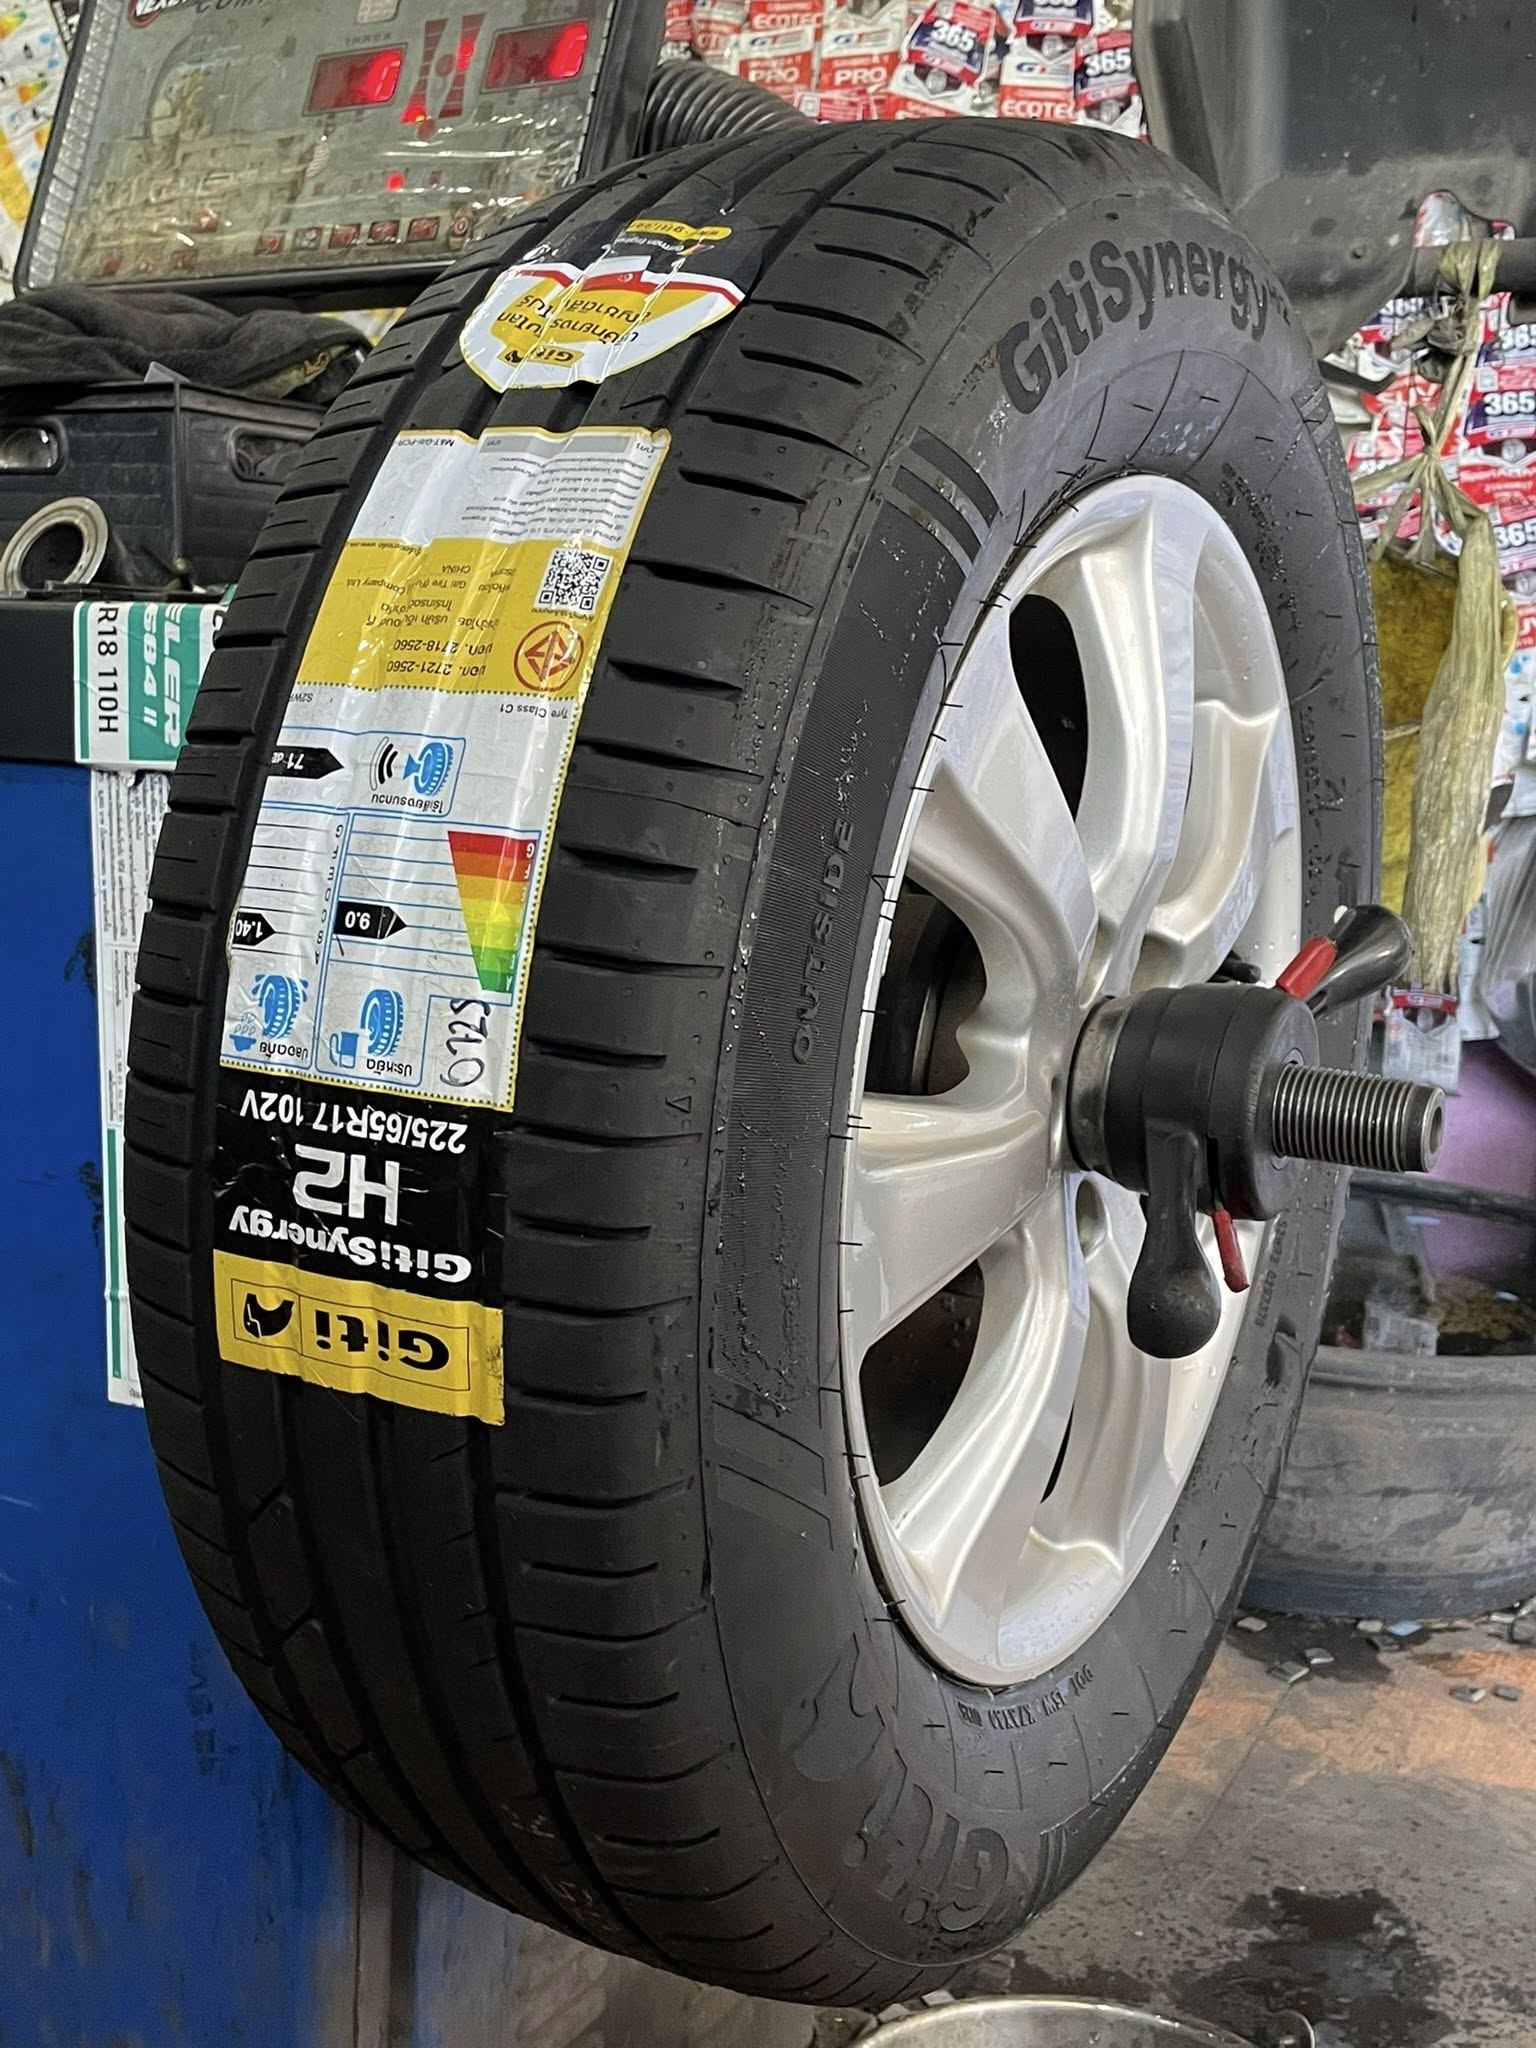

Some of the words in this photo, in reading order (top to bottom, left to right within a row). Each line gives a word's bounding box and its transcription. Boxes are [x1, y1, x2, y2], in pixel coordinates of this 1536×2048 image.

[930, 19, 977, 52] 365
[1085, 48, 1131, 77] 365
[834, 66, 887, 86] PRO
[1483, 391, 1536, 415] 365
[98, 607, 118, 656] R18
[393, 639, 459, 654] 2718-2560
[387, 660, 453, 674] 2721-2560
[98, 667, 118, 732] 110H
[500, 703, 513, 713] C1
[517, 703, 547, 718] Class
[551, 708, 569, 719] Tyre
[287, 753, 305, 770] 71
[236, 919, 263, 937] 1.40
[345, 910, 371, 930] 9.0
[792, 819, 853, 1066] OUTSIDE
[366, 1057, 412, 1076] ประหยัด
[240, 1089, 304, 1126] 102V
[312, 1101, 468, 1154] 225/65R17
[292, 1143, 400, 1226] H2
[229, 1205, 472, 1283] GitiSynergy
[315, 1309, 450, 1371] Giti
